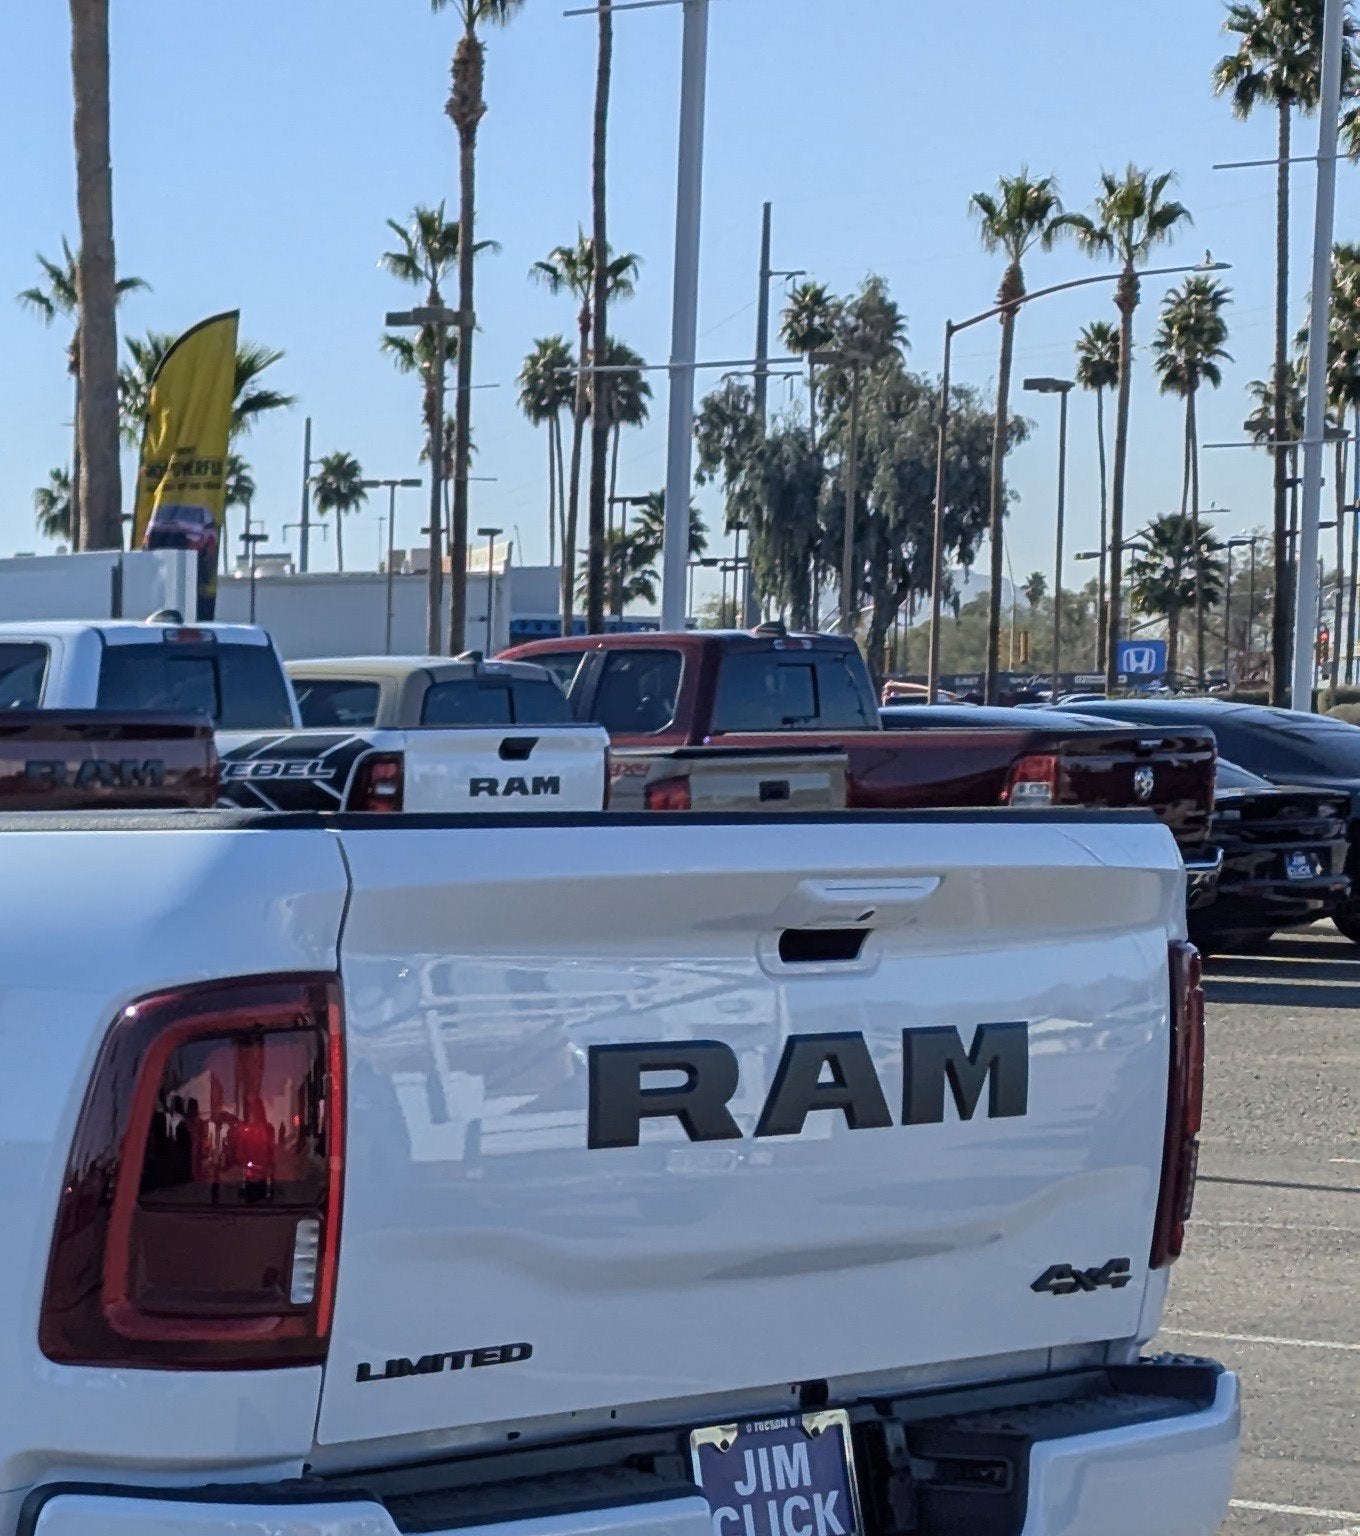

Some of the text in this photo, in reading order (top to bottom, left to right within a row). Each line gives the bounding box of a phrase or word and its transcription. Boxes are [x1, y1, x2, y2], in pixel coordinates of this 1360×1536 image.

[24, 759, 166, 790] RAM
[469, 775, 561, 797] RAM
[587, 1021, 1030, 1150] RAM
[355, 1342, 533, 1383] LIMITED
[734, 1441, 812, 1497] JIM
